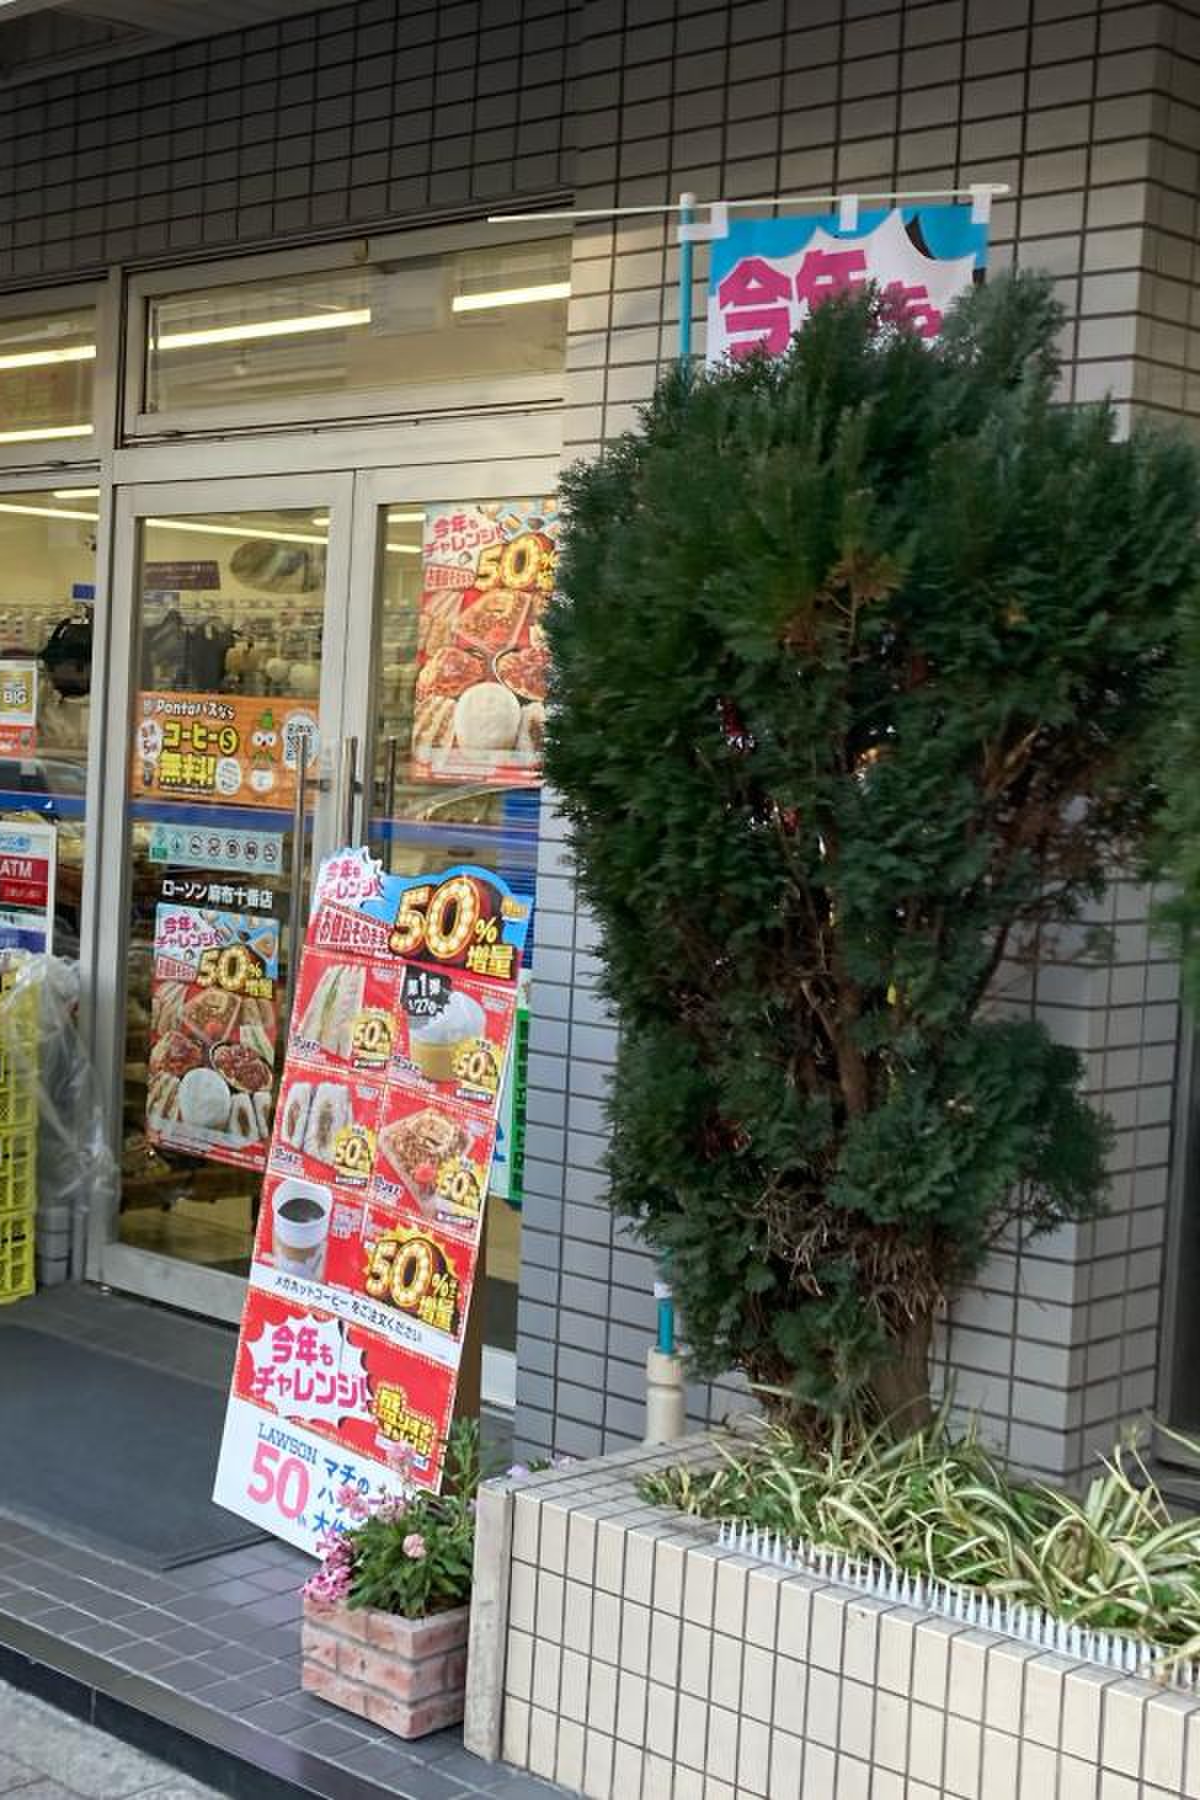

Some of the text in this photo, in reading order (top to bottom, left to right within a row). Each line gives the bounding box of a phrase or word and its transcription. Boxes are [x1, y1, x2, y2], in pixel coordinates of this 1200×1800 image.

[388, 874, 498, 961] 50%
[465, 942, 514, 980] 増量
[273, 1276, 351, 1312] メガホットコーヒー
[271, 1325, 334, 1367] 今年も
[258, 1423, 318, 1465] LAWSON
[247, 1441, 310, 1520] 50
[323, 1457, 370, 1496] マチの
